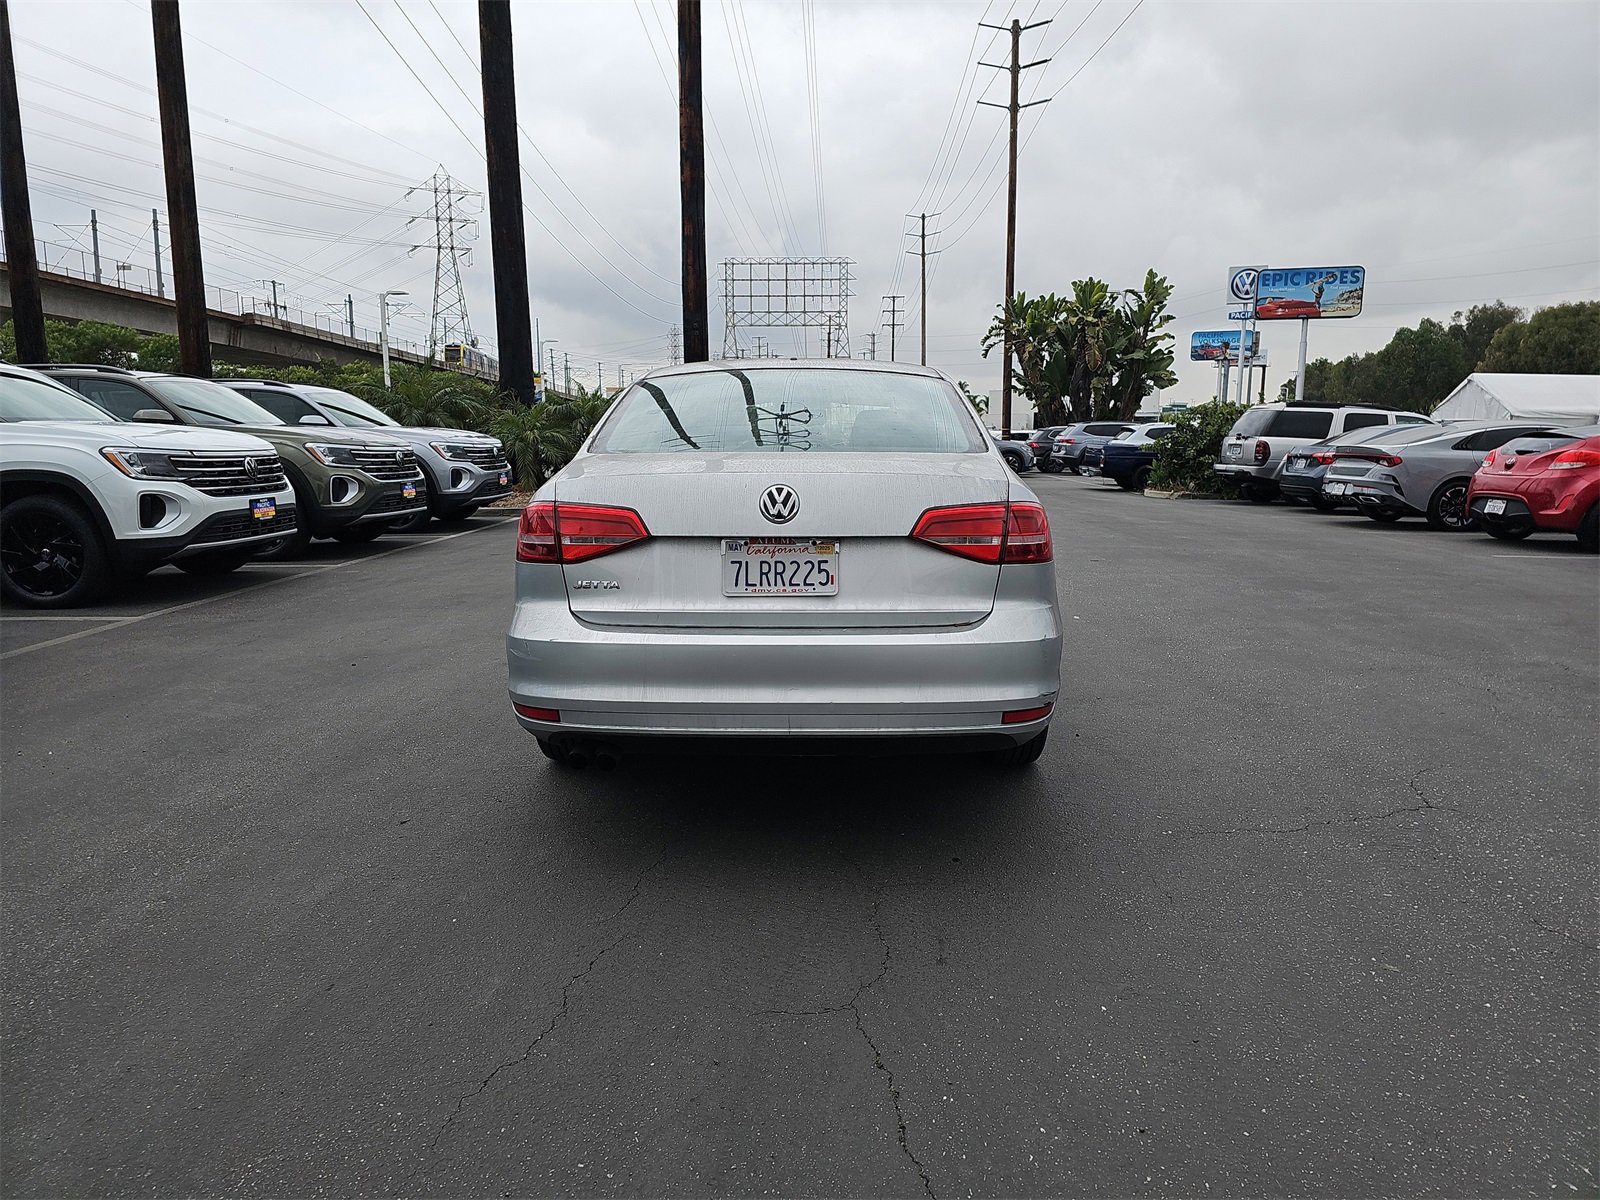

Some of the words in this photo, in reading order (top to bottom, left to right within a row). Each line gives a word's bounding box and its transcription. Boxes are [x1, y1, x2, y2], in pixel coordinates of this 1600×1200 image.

[1261, 272, 1300, 287] EPIC
[1306, 270, 1361, 286] RIDES
[746, 545, 812, 558] California
[730, 560, 830, 587] 7LRR225
[573, 580, 620, 589] JETTA
